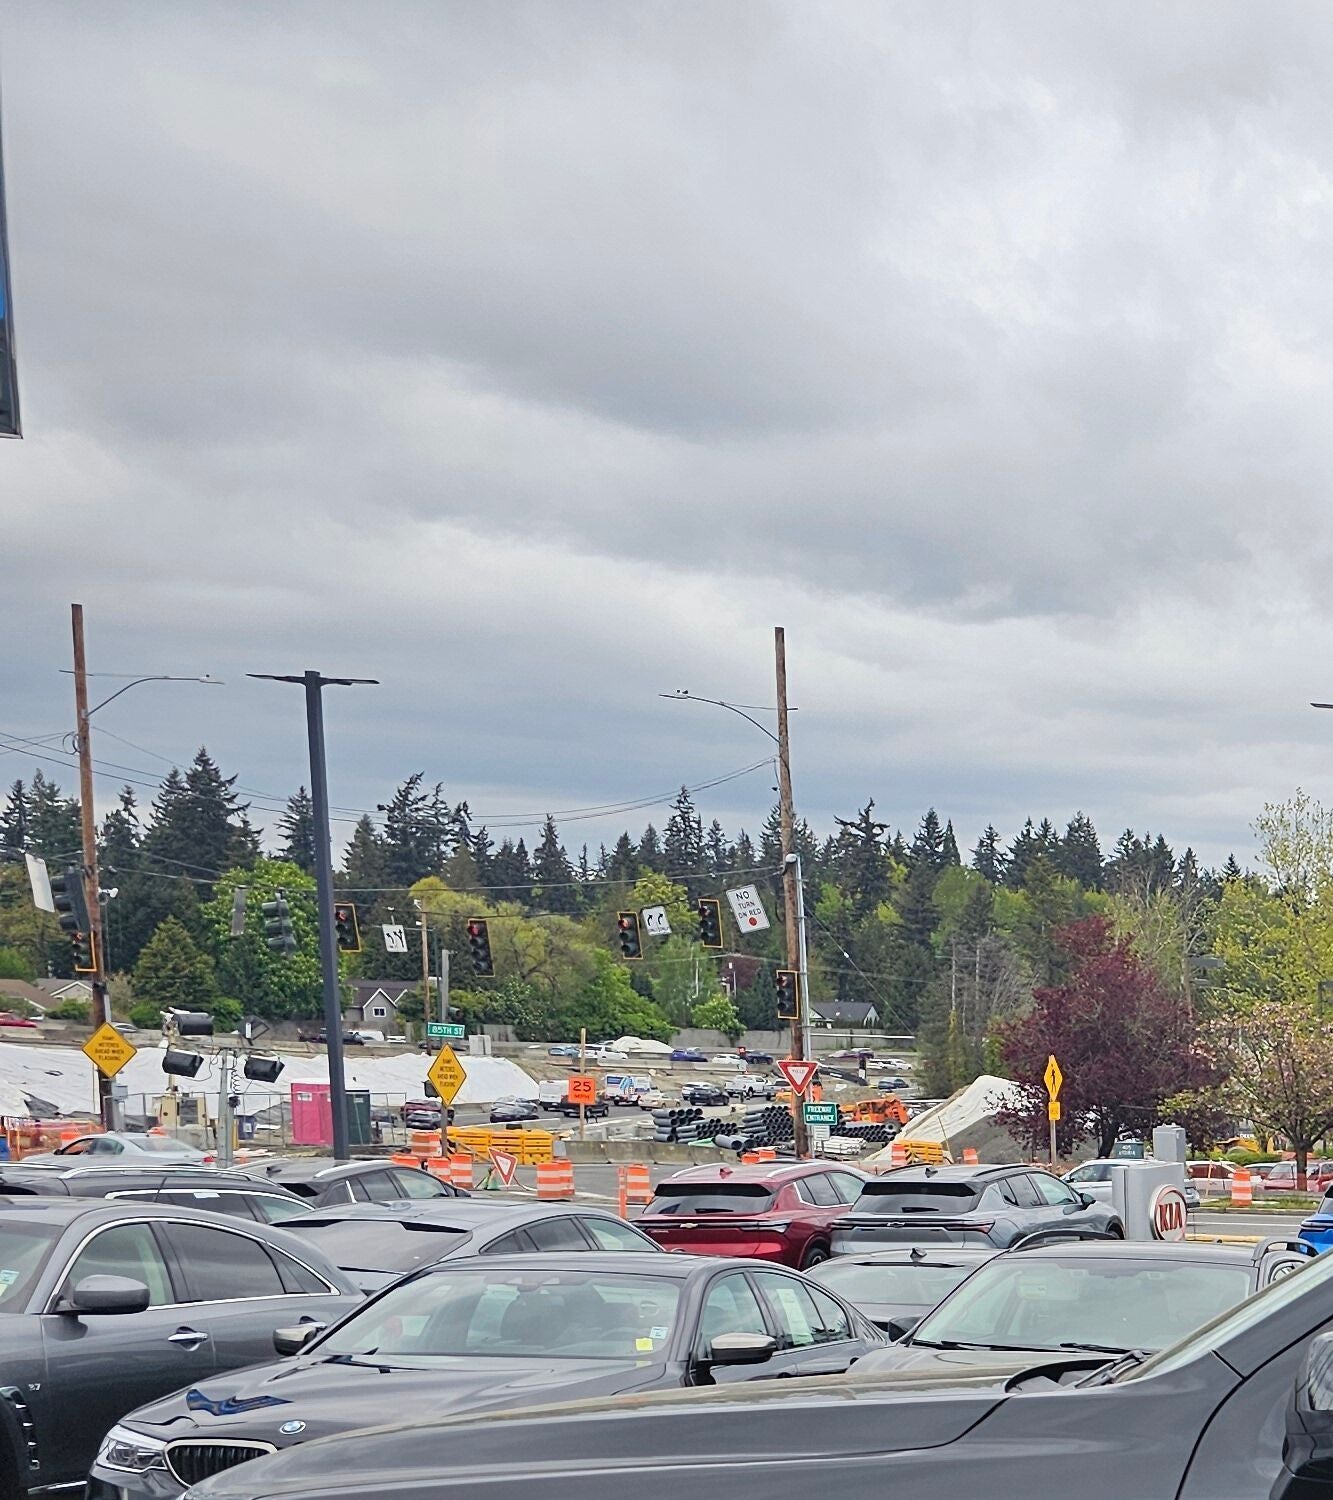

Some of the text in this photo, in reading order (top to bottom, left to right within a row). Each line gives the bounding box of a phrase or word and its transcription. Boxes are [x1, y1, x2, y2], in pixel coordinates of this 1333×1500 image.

[736, 890, 750, 900] NO
[738, 901, 755, 909] TURN
[738, 908, 761, 919] ON RED
[431, 1025, 463, 1036] 85TH ST
[573, 1080, 592, 1092] 25
[807, 1105, 832, 1113] FREEWAY
[806, 1114, 835, 1122] ENTRANCE
[1158, 1201, 1183, 1232] KIA
